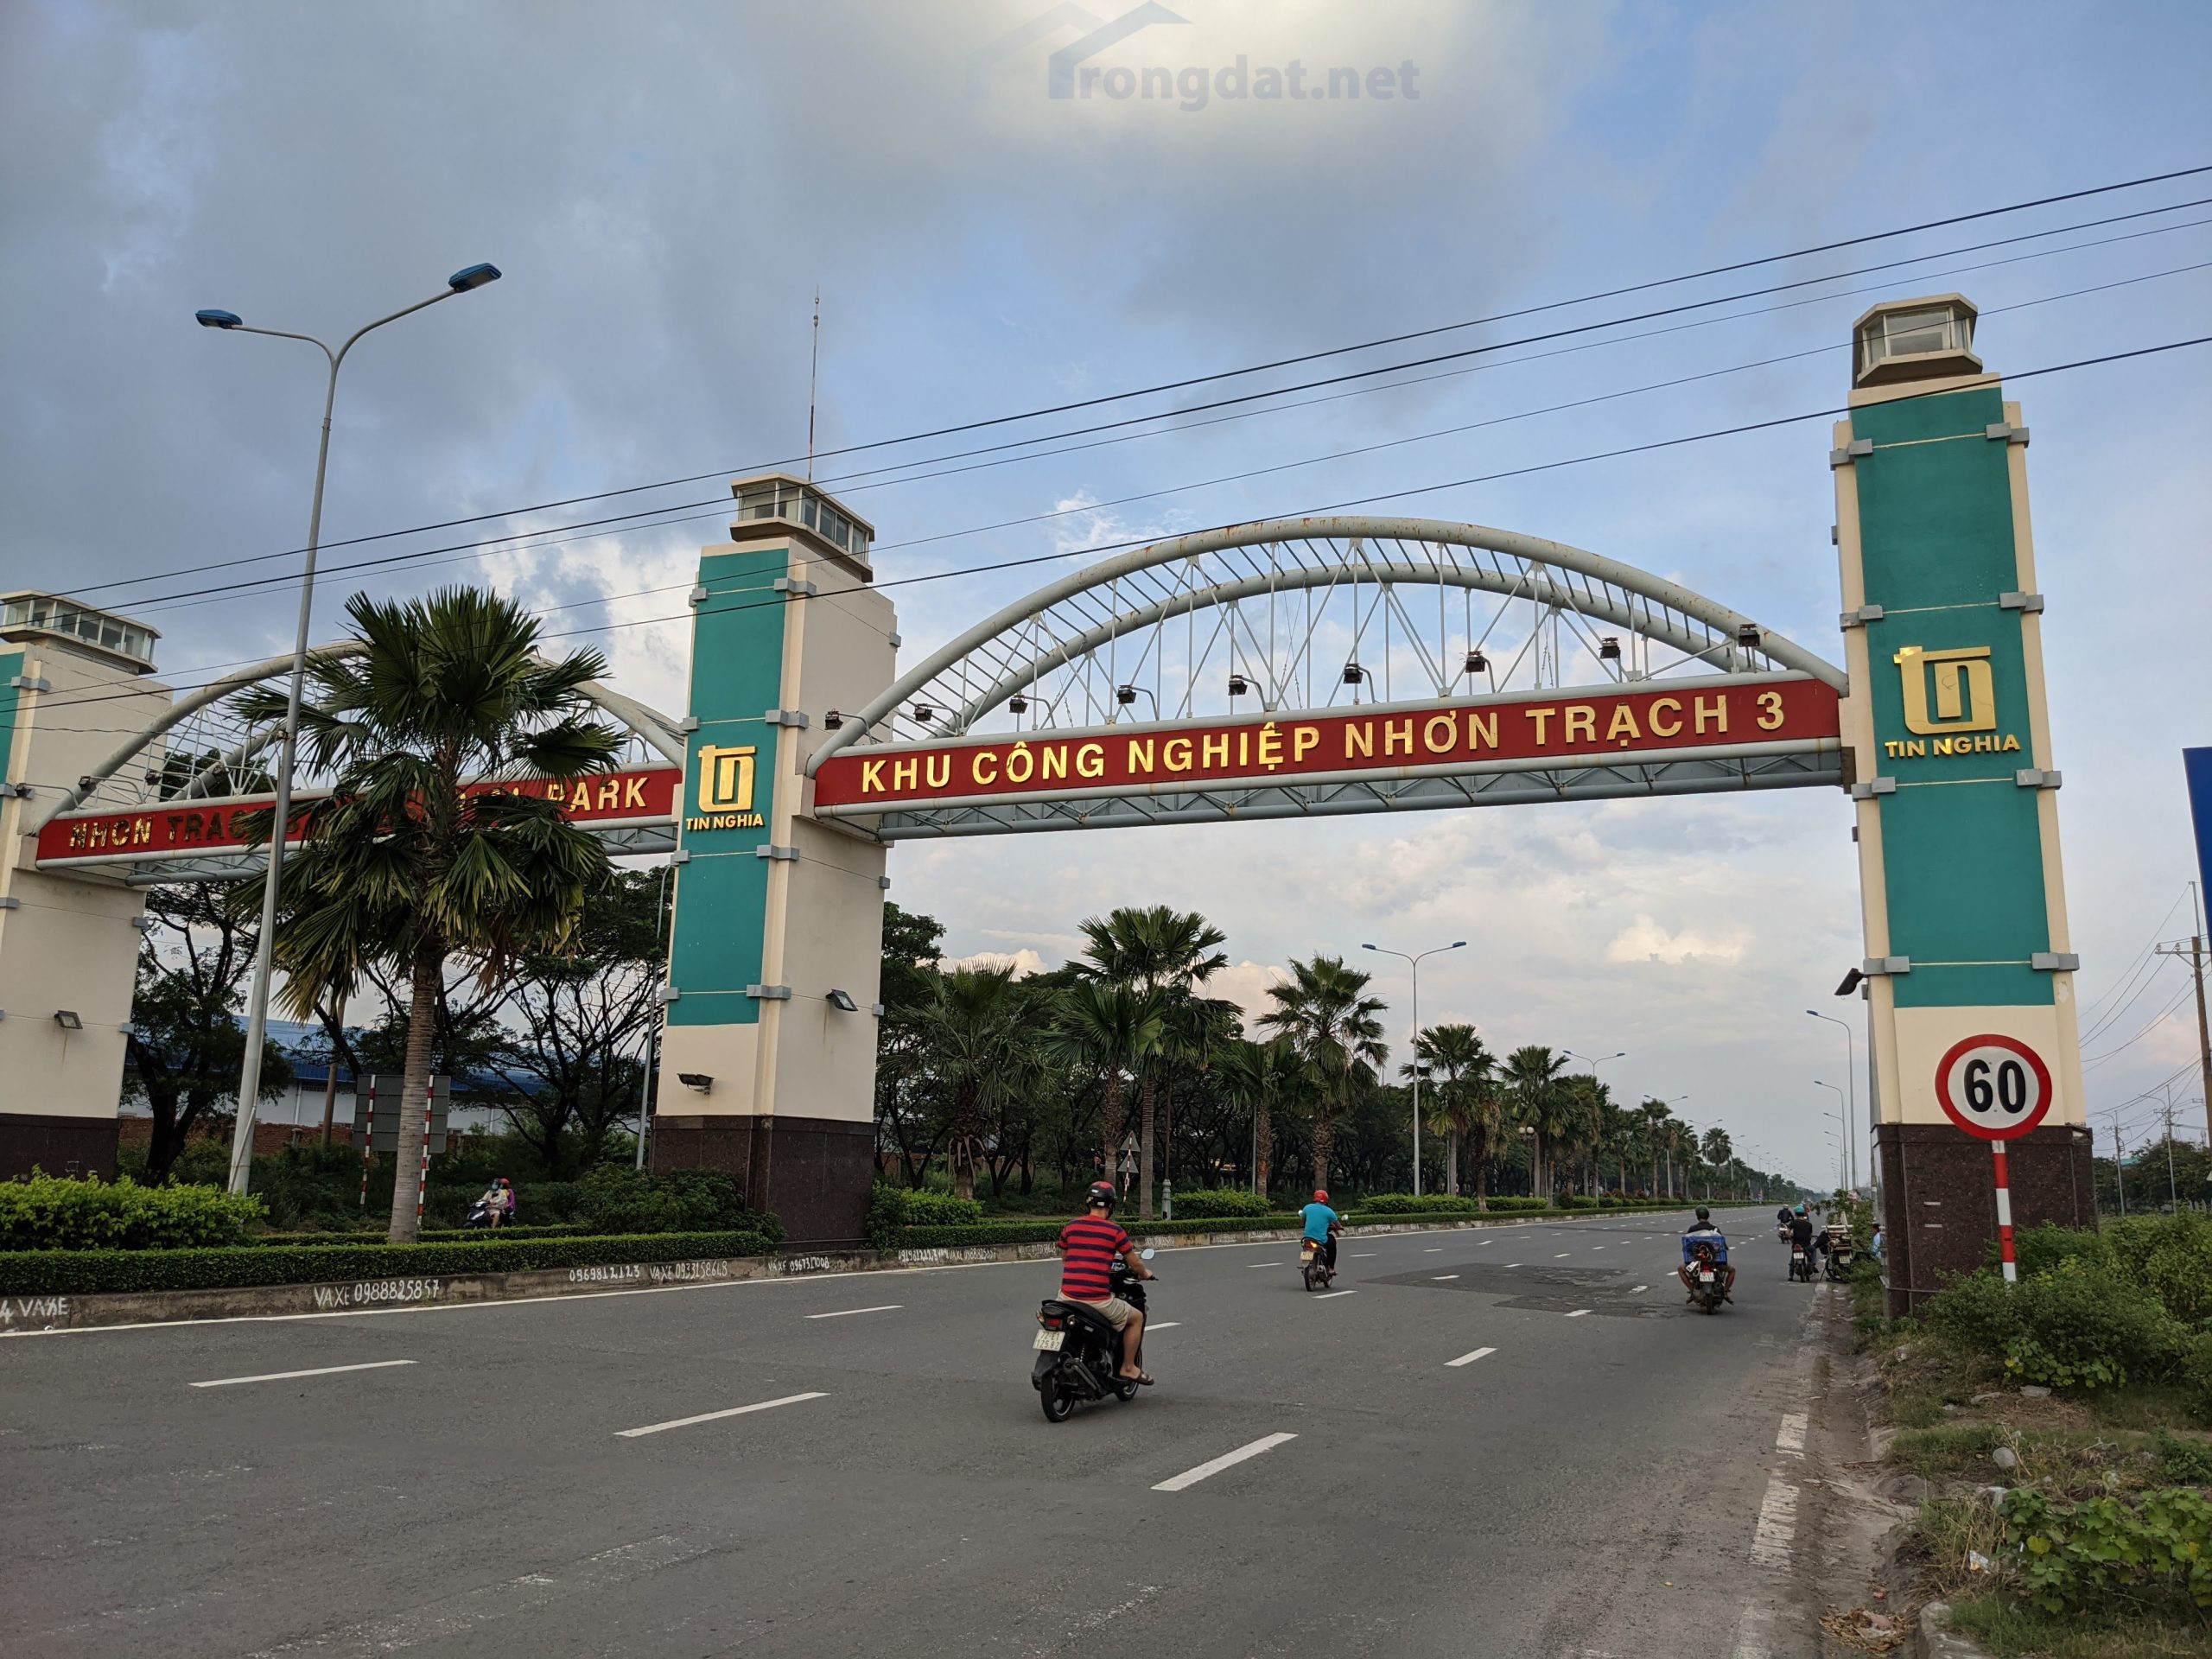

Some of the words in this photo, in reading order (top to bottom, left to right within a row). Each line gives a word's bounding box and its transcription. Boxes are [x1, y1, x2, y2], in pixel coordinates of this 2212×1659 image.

[861, 753, 951, 793] KHU
[972, 741, 1105, 785] CÔNG
[1127, 721, 1320, 774] NGHIỆP
[1344, 709, 1498, 759] NHƠN
[1524, 694, 1728, 747] TRẠCH
[1756, 690, 1785, 731] 3
[1885, 740, 1926, 758] TIN
[1932, 734, 2021, 756] NGHIA
[547, 777, 648, 812] PARK
[685, 817, 710, 830] TIN
[713, 813, 764, 829] NGHIA
[1964, 1058, 2026, 1115] 60
